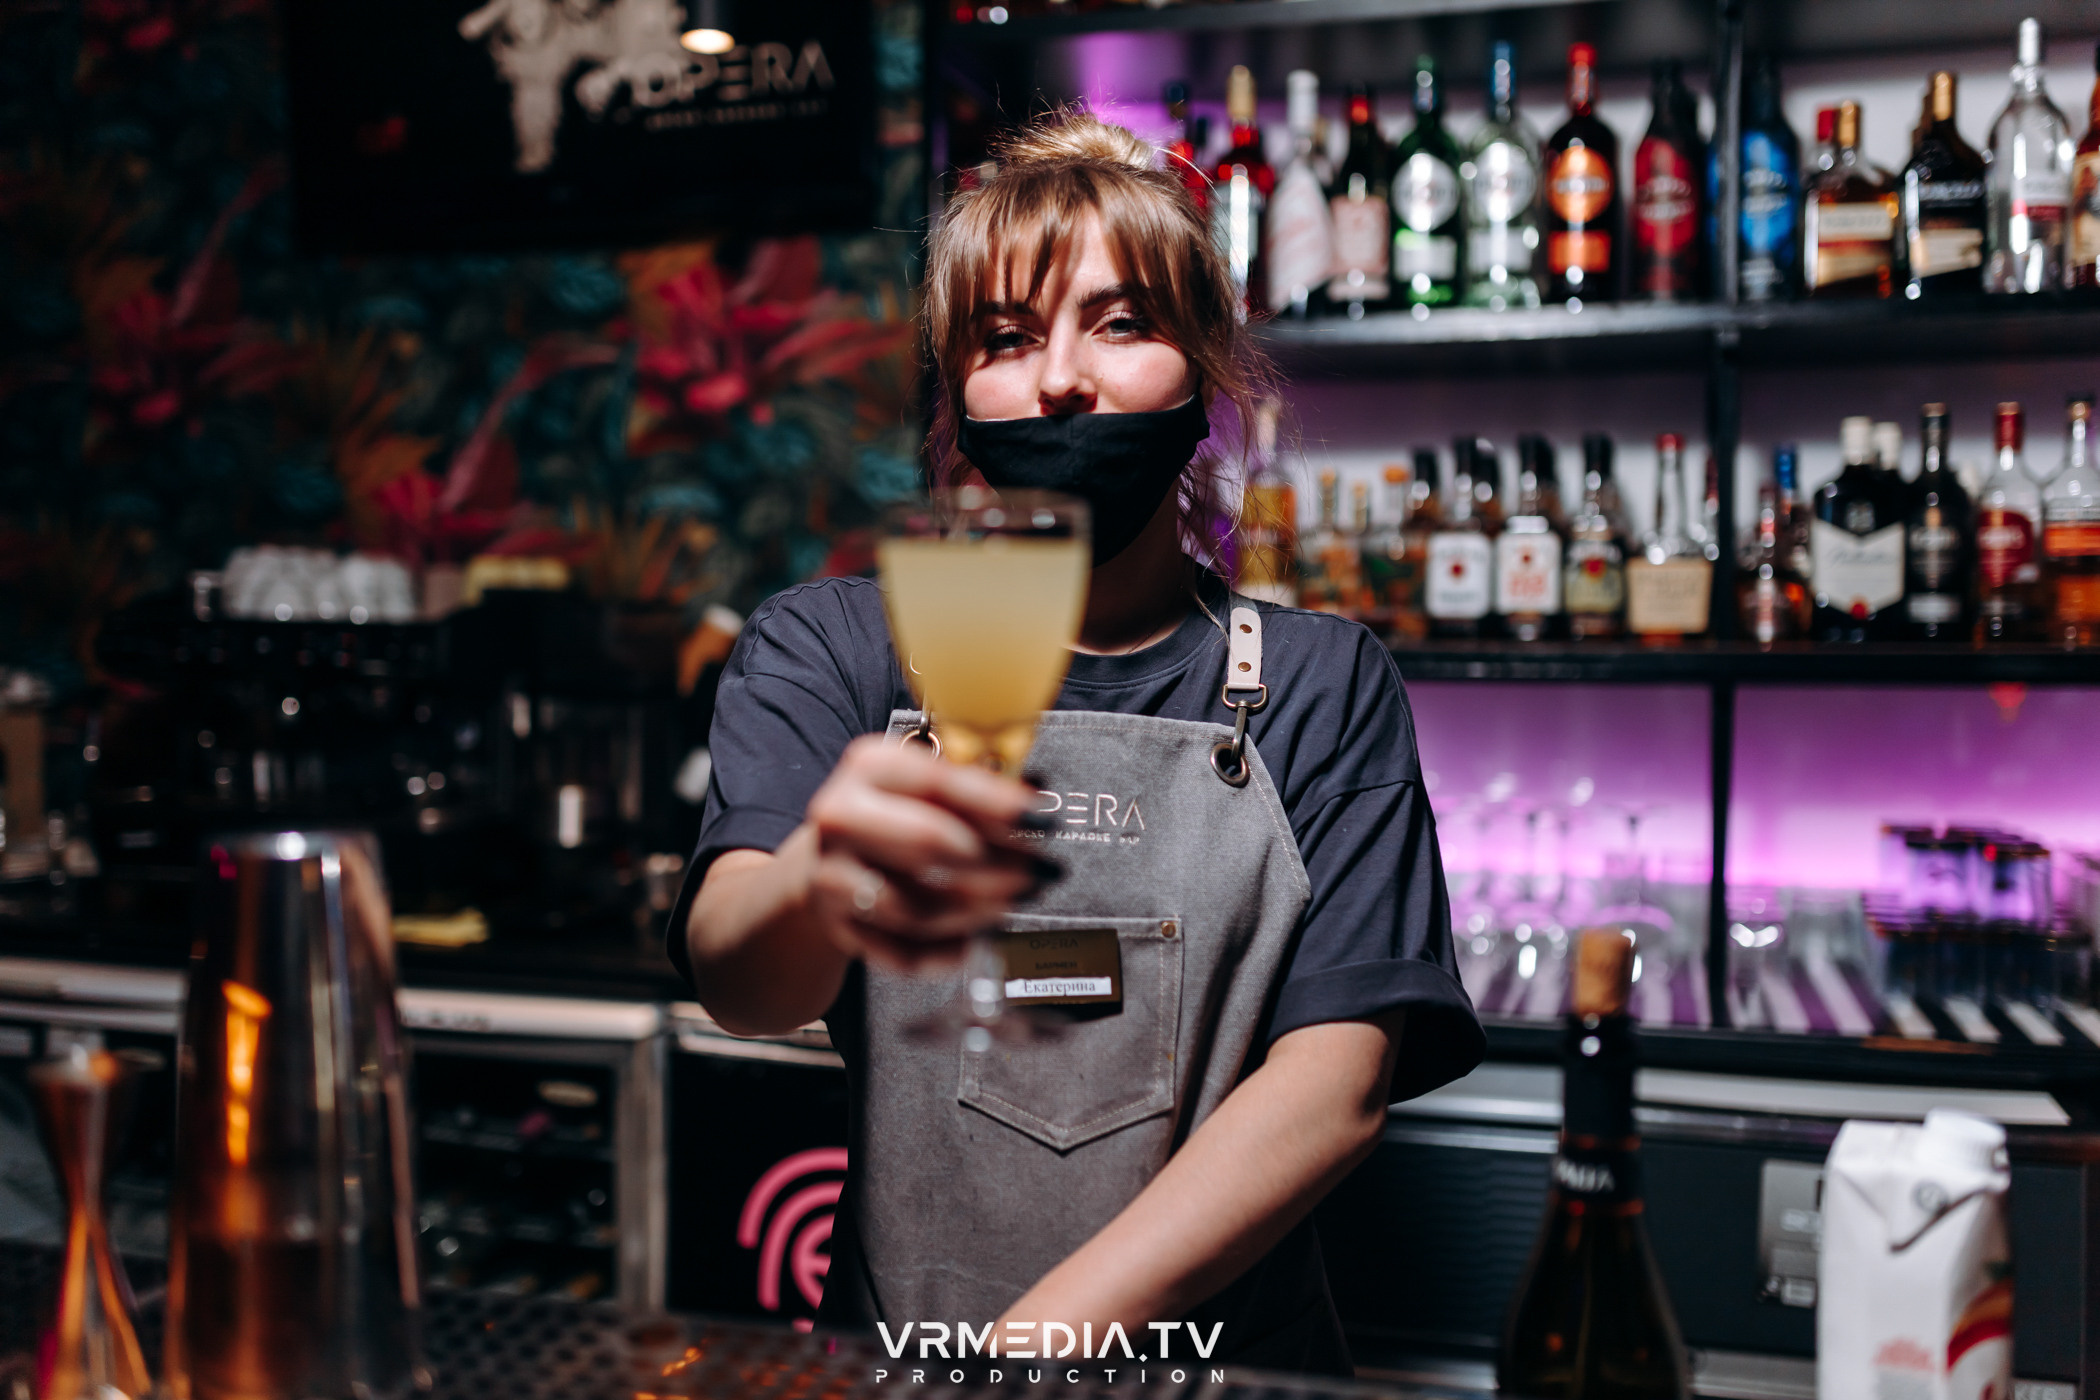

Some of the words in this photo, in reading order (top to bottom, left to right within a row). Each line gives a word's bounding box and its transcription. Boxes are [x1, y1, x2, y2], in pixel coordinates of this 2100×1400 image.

[634, 41, 835, 107] OPERA
[1036, 790, 1146, 831] PERA
[1055, 830, 1111, 843] КАРАОКЕ
[1029, 937, 1079, 950] OPERA
[1024, 981, 1096, 996] Екатерина
